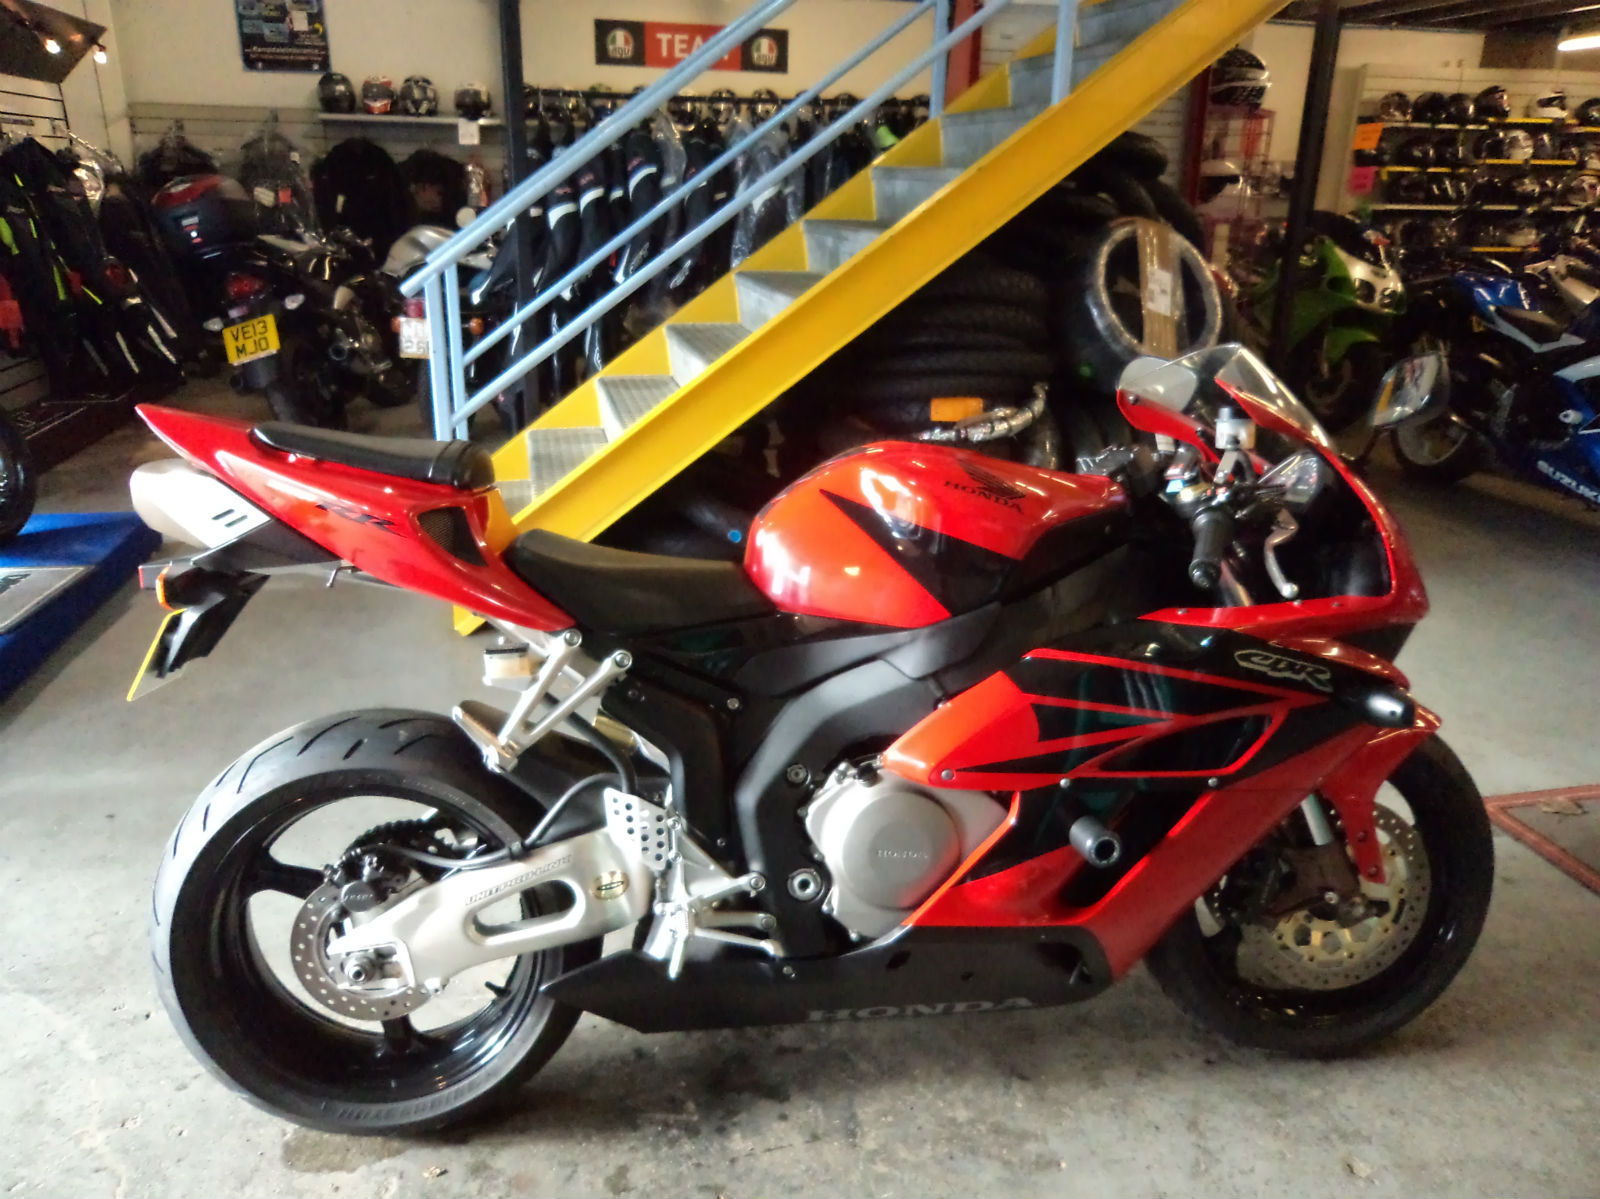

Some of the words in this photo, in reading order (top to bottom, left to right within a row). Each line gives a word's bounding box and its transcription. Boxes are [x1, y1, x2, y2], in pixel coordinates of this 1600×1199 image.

[656, 33, 729, 61] TEA
[230, 320, 268, 342] VE13
[944, 481, 1024, 515] HONDA
[1234, 649, 1334, 693] CBR
[876, 848, 930, 859] HONDA
[807, 997, 1034, 1021] HONDA
